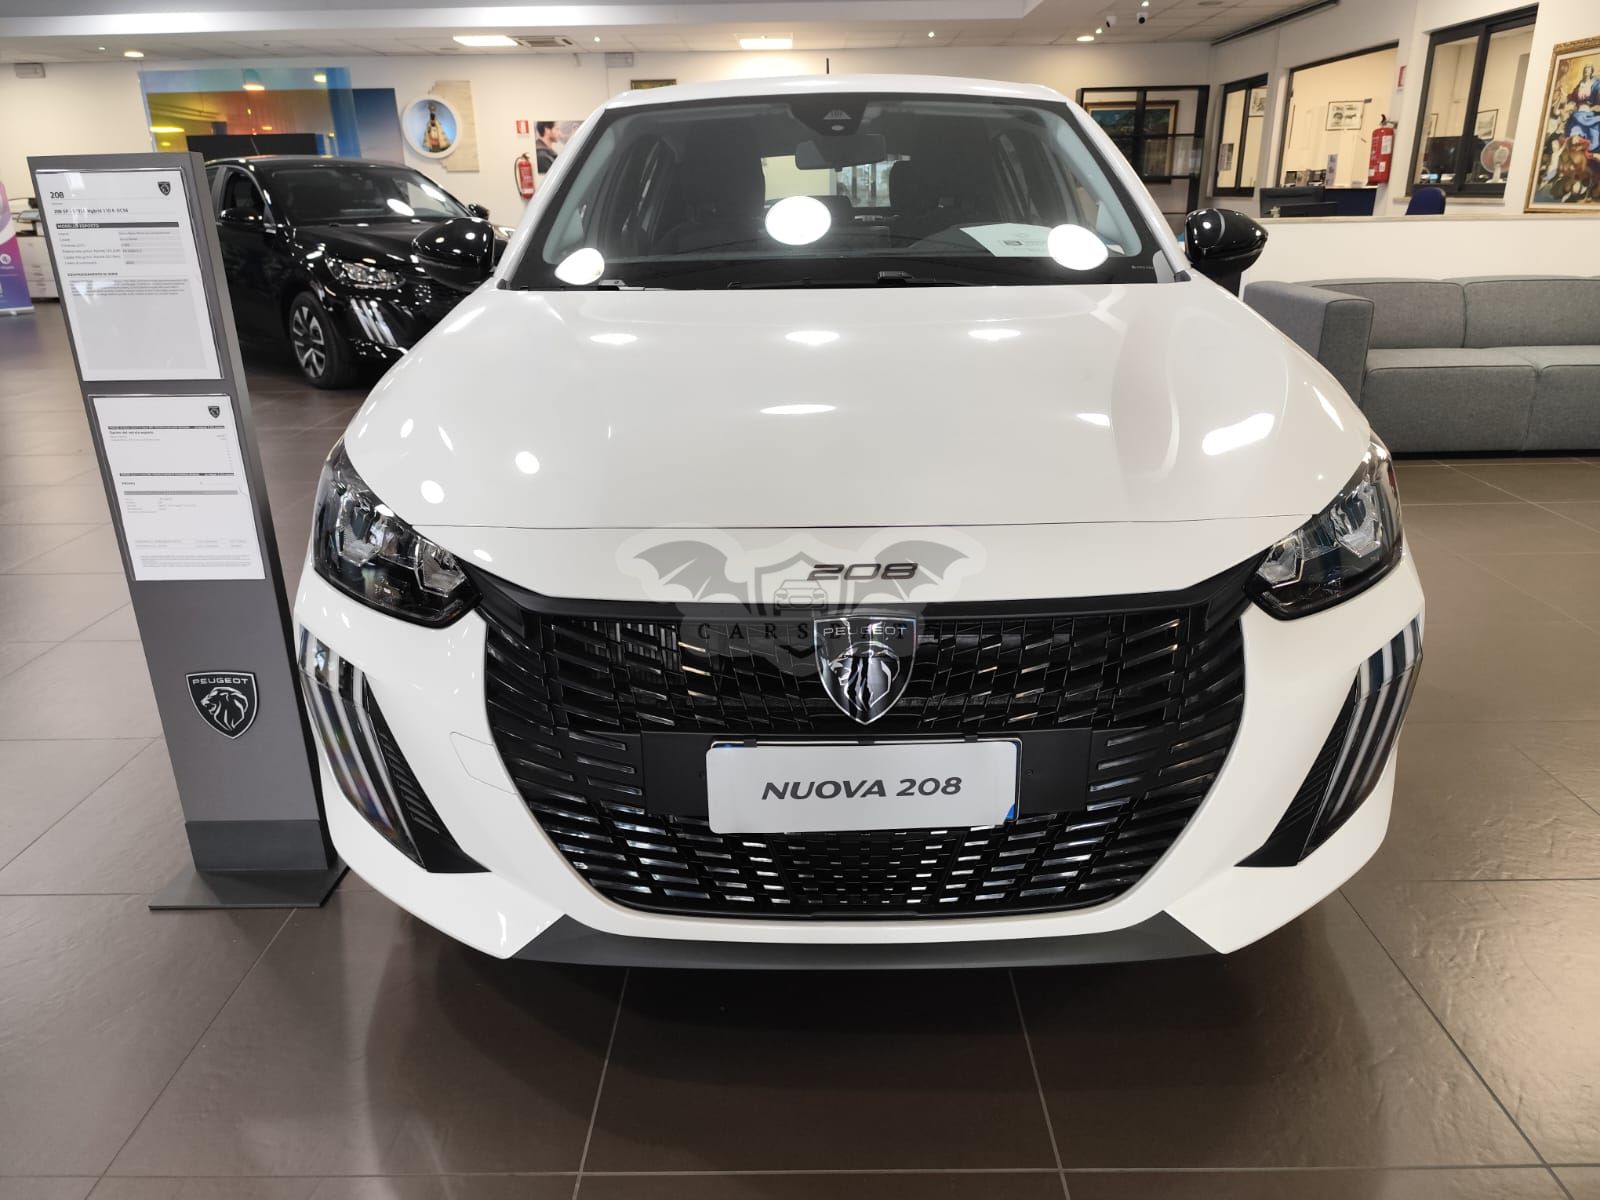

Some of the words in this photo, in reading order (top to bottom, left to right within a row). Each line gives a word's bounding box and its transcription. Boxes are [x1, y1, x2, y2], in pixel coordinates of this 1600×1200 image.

[50, 191, 64, 199] 208
[807, 563, 918, 581] 208
[823, 625, 908, 637] PEUGEOT
[192, 677, 249, 685] PEUGEOT
[761, 779, 887, 801] NUOVA
[895, 777, 962, 797] 208
